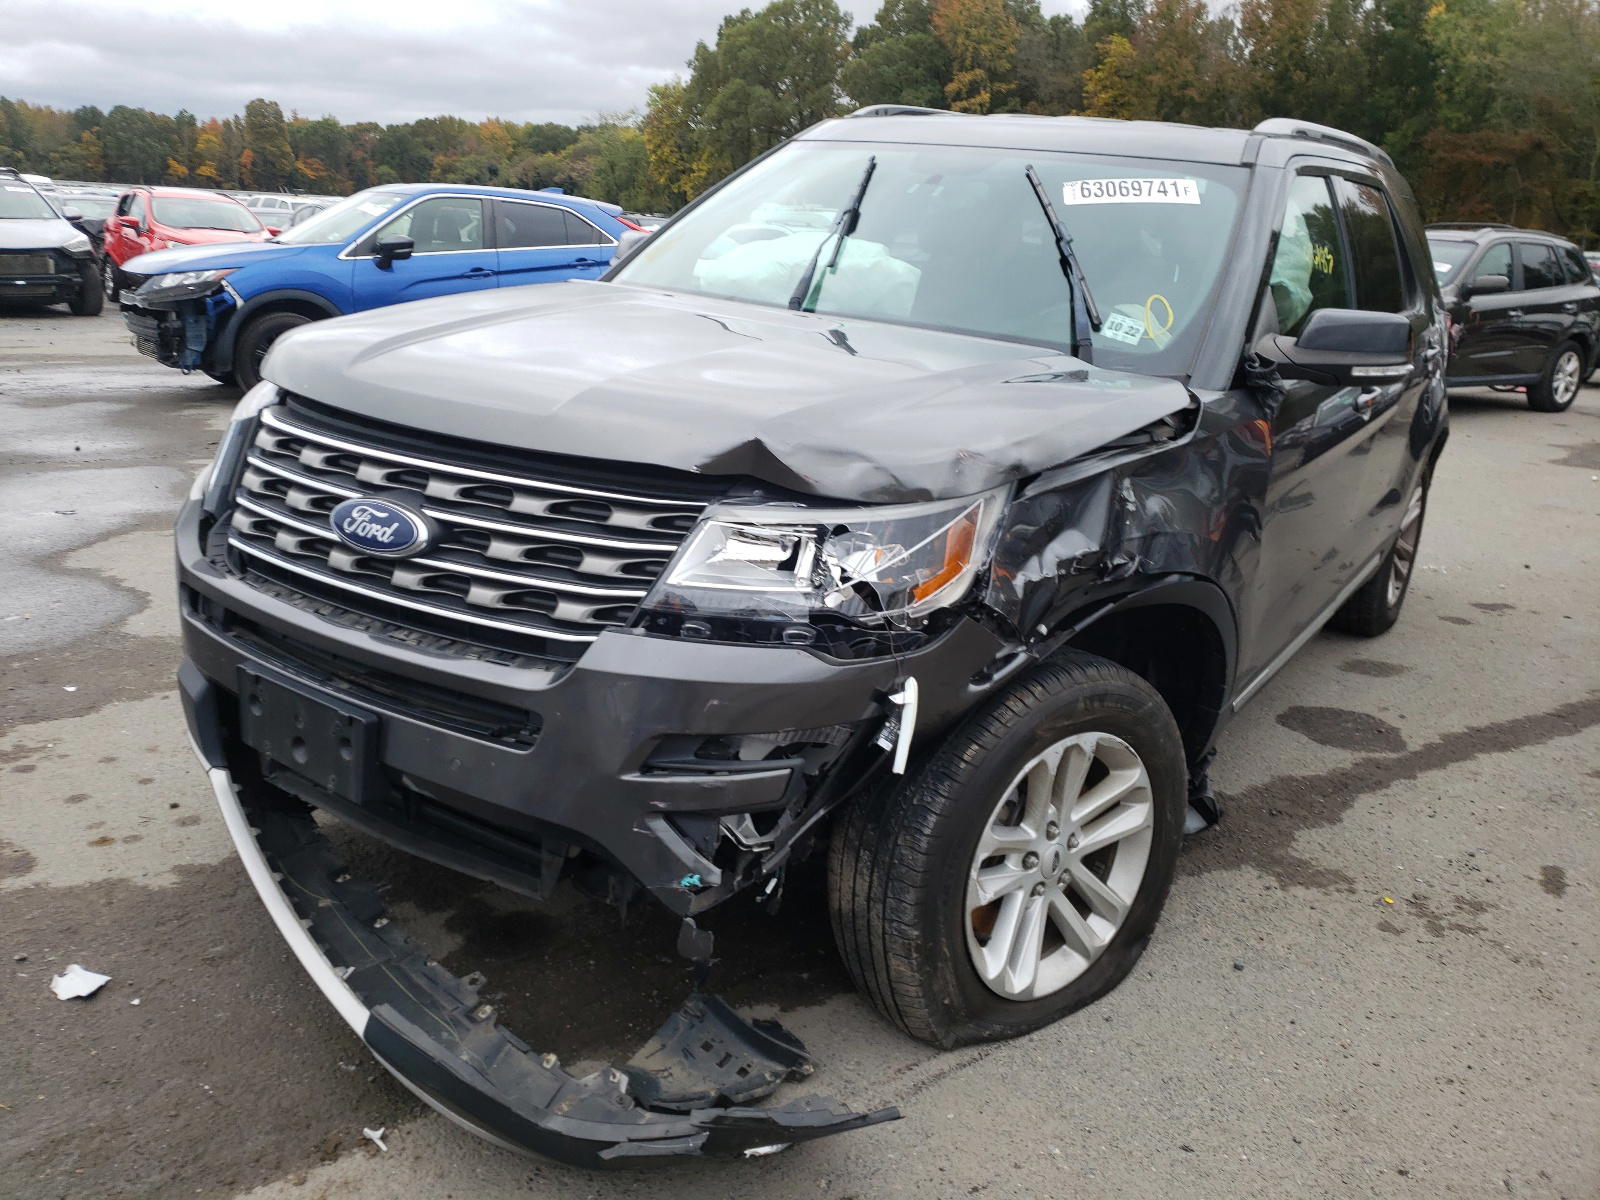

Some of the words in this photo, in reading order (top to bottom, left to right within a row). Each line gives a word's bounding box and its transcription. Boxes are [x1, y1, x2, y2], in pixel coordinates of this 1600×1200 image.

[1080, 180, 1180, 198] 63069741
[1107, 320, 1123, 332] 10
[343, 505, 400, 543] Ford
